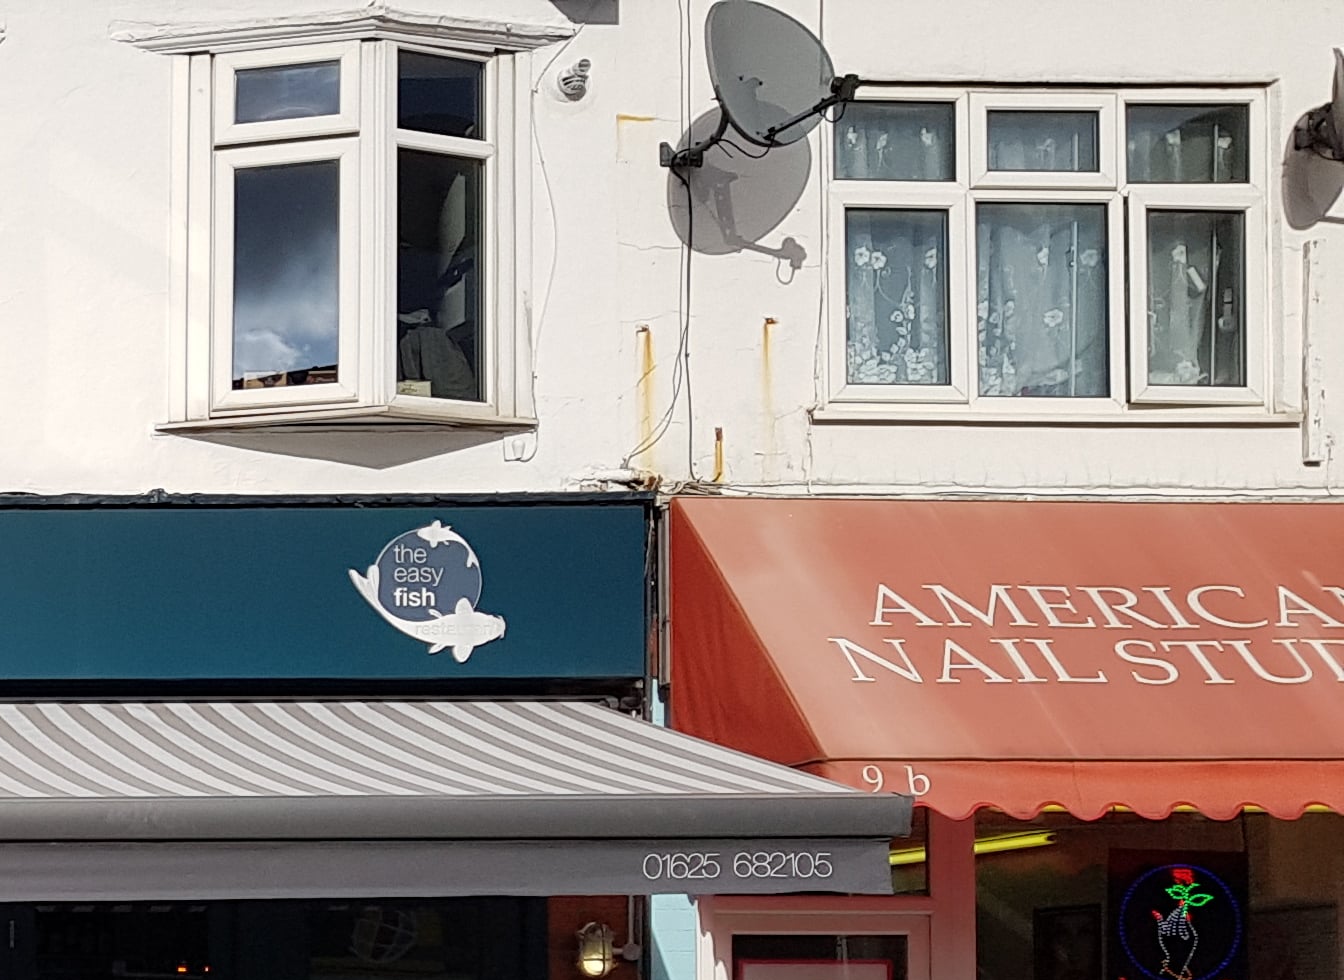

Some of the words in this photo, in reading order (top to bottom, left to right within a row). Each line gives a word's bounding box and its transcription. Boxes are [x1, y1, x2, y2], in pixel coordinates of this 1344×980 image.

[393, 544, 427, 564] the
[393, 566, 444, 586] easy
[393, 587, 435, 607] fish
[868, 583, 1344, 629] AMERICA
[827, 637, 1108, 684] NAIL
[862, 765, 884, 794] 9
[904, 765, 930, 796] b
[642, 852, 721, 880] 01625
[733, 851, 833, 879] 682105
